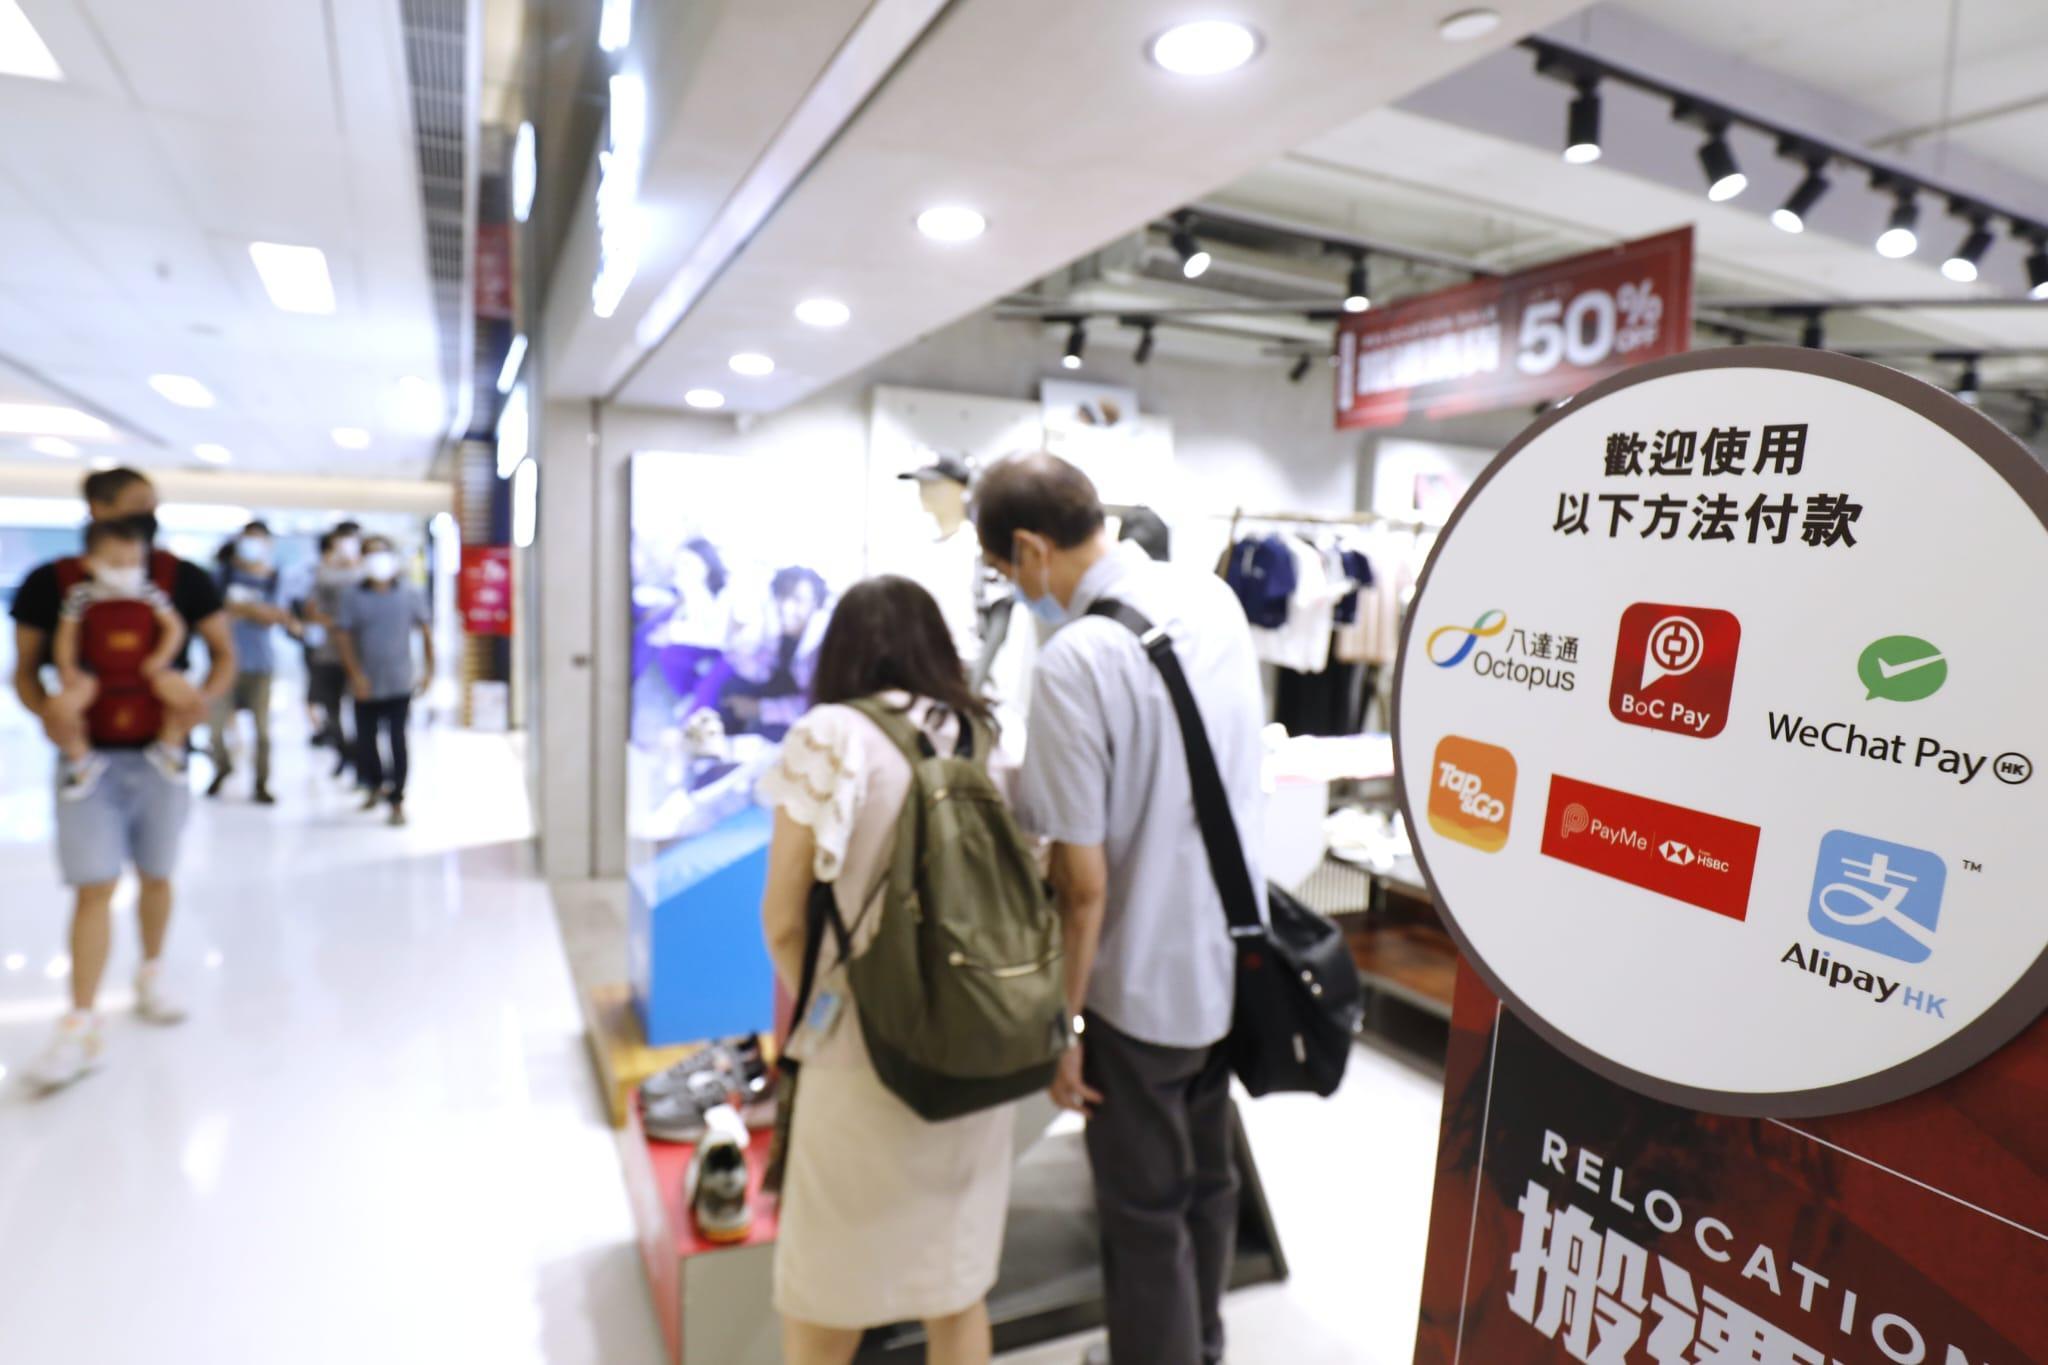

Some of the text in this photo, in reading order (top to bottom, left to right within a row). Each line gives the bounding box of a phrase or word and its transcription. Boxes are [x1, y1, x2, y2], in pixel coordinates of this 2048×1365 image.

[1516, 277, 1664, 375] 50%
[1603, 423, 1809, 477] 歡迎使用
[1553, 492, 1864, 548] 以下方法付款
[1505, 628, 1580, 664] 八達通
[1473, 650, 1576, 692] Octopus
[1621, 693, 1711, 732] BoC Pay
[1768, 711, 1906, 764] WeChat
[1914, 737, 1987, 785] Pay
[1439, 761, 1482, 801] Tap
[1590, 818, 1648, 851] PayMe
[1697, 855, 1729, 873] HSBC
[1962, 859, 1983, 873] TM
[1780, 942, 1948, 1019] Alipay HK
